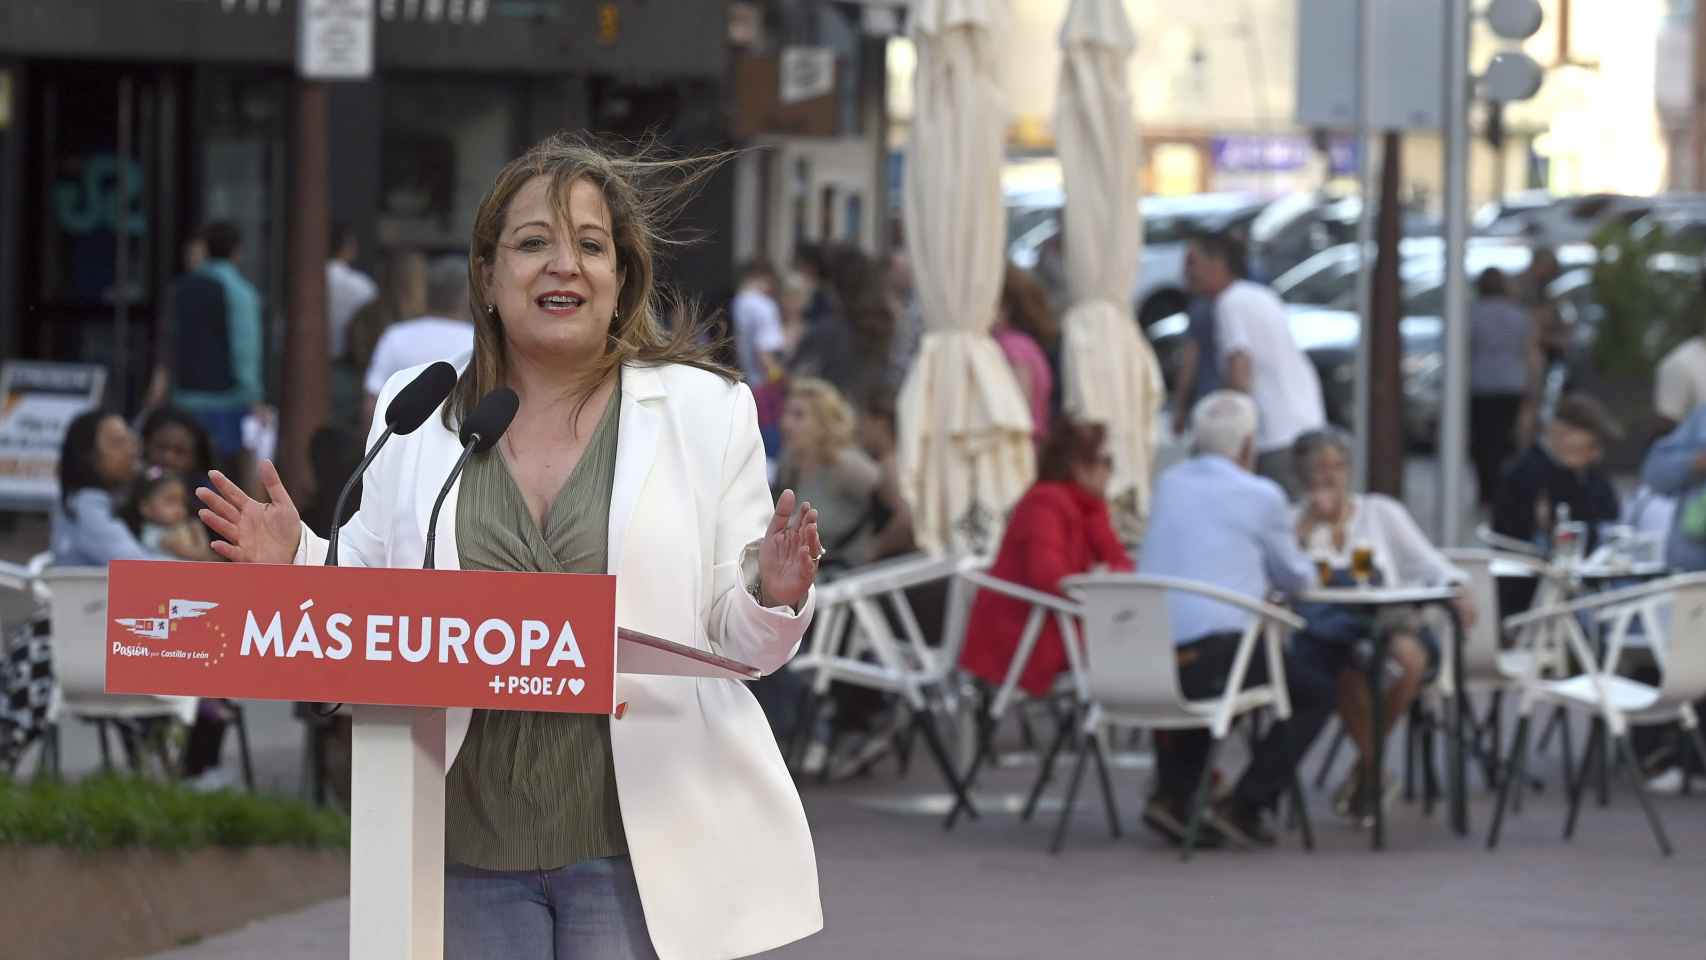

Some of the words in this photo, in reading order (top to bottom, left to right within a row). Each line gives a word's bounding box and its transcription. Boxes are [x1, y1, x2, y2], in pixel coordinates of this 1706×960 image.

[112, 641, 149, 657] Pasión
[160, 649, 186, 659] Castilla
[187, 652, 192, 660] y
[192, 650, 209, 659] León
[239, 599, 353, 660] MÁS
[365, 614, 586, 668] EUROPA
